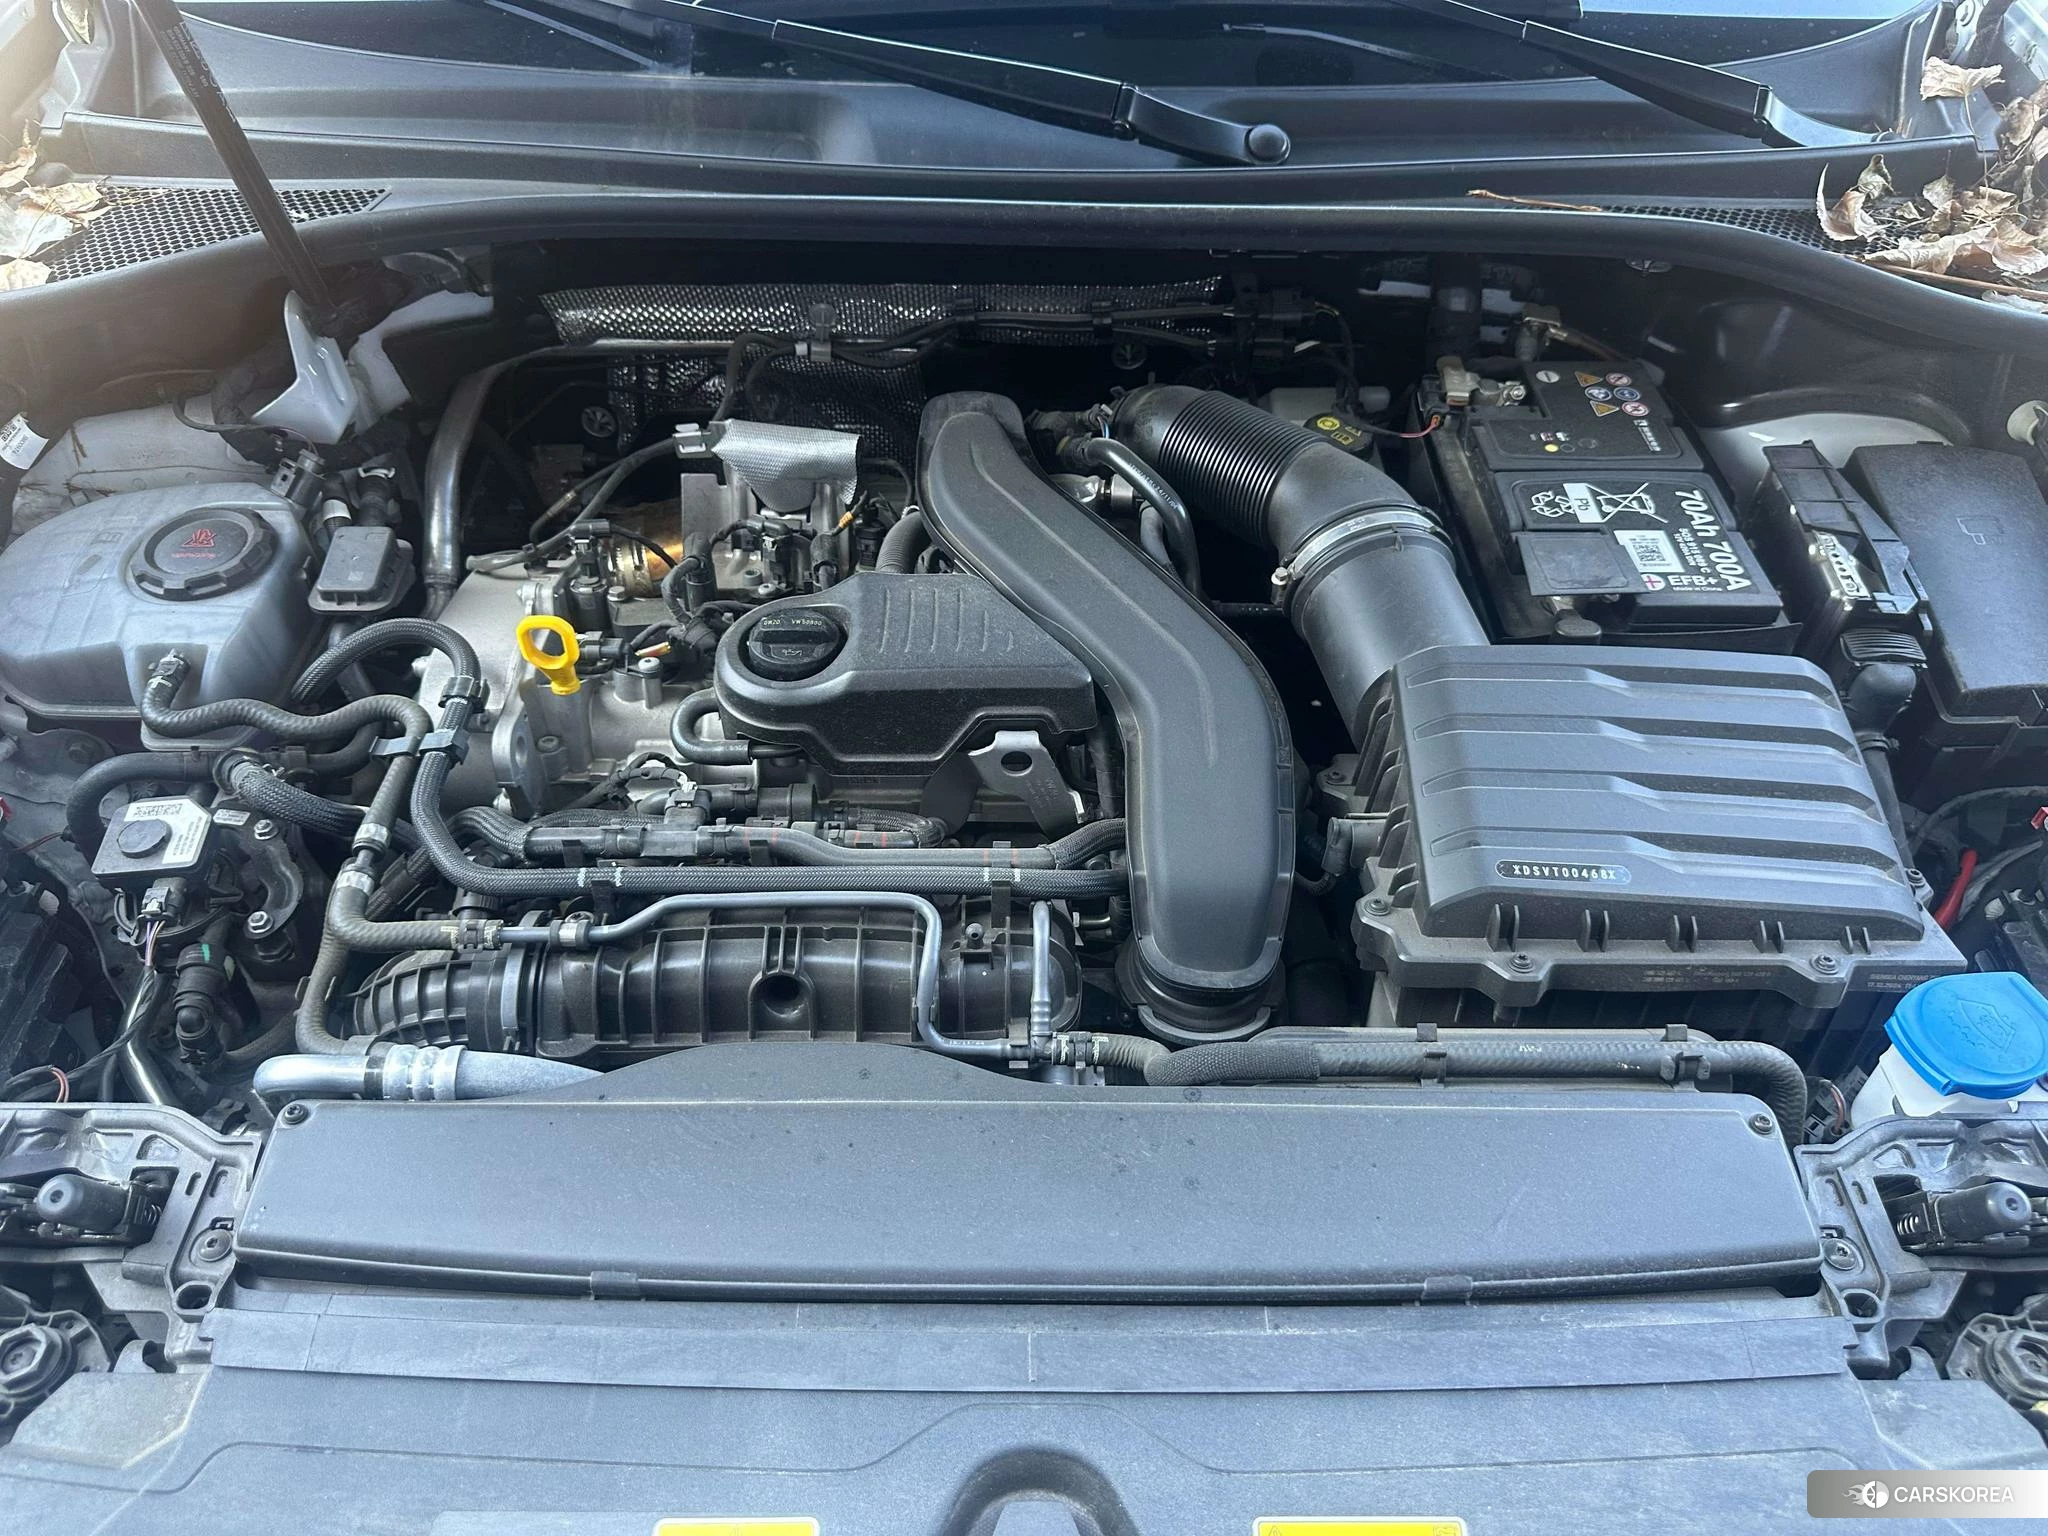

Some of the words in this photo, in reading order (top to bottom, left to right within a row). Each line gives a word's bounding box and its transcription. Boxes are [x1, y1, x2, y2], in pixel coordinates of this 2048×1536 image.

[1574, 498, 1590, 511] Pb
[1675, 490, 1720, 537] 70Ah
[1702, 541, 1752, 591] 700A
[1667, 575, 1718, 586] EFB+
